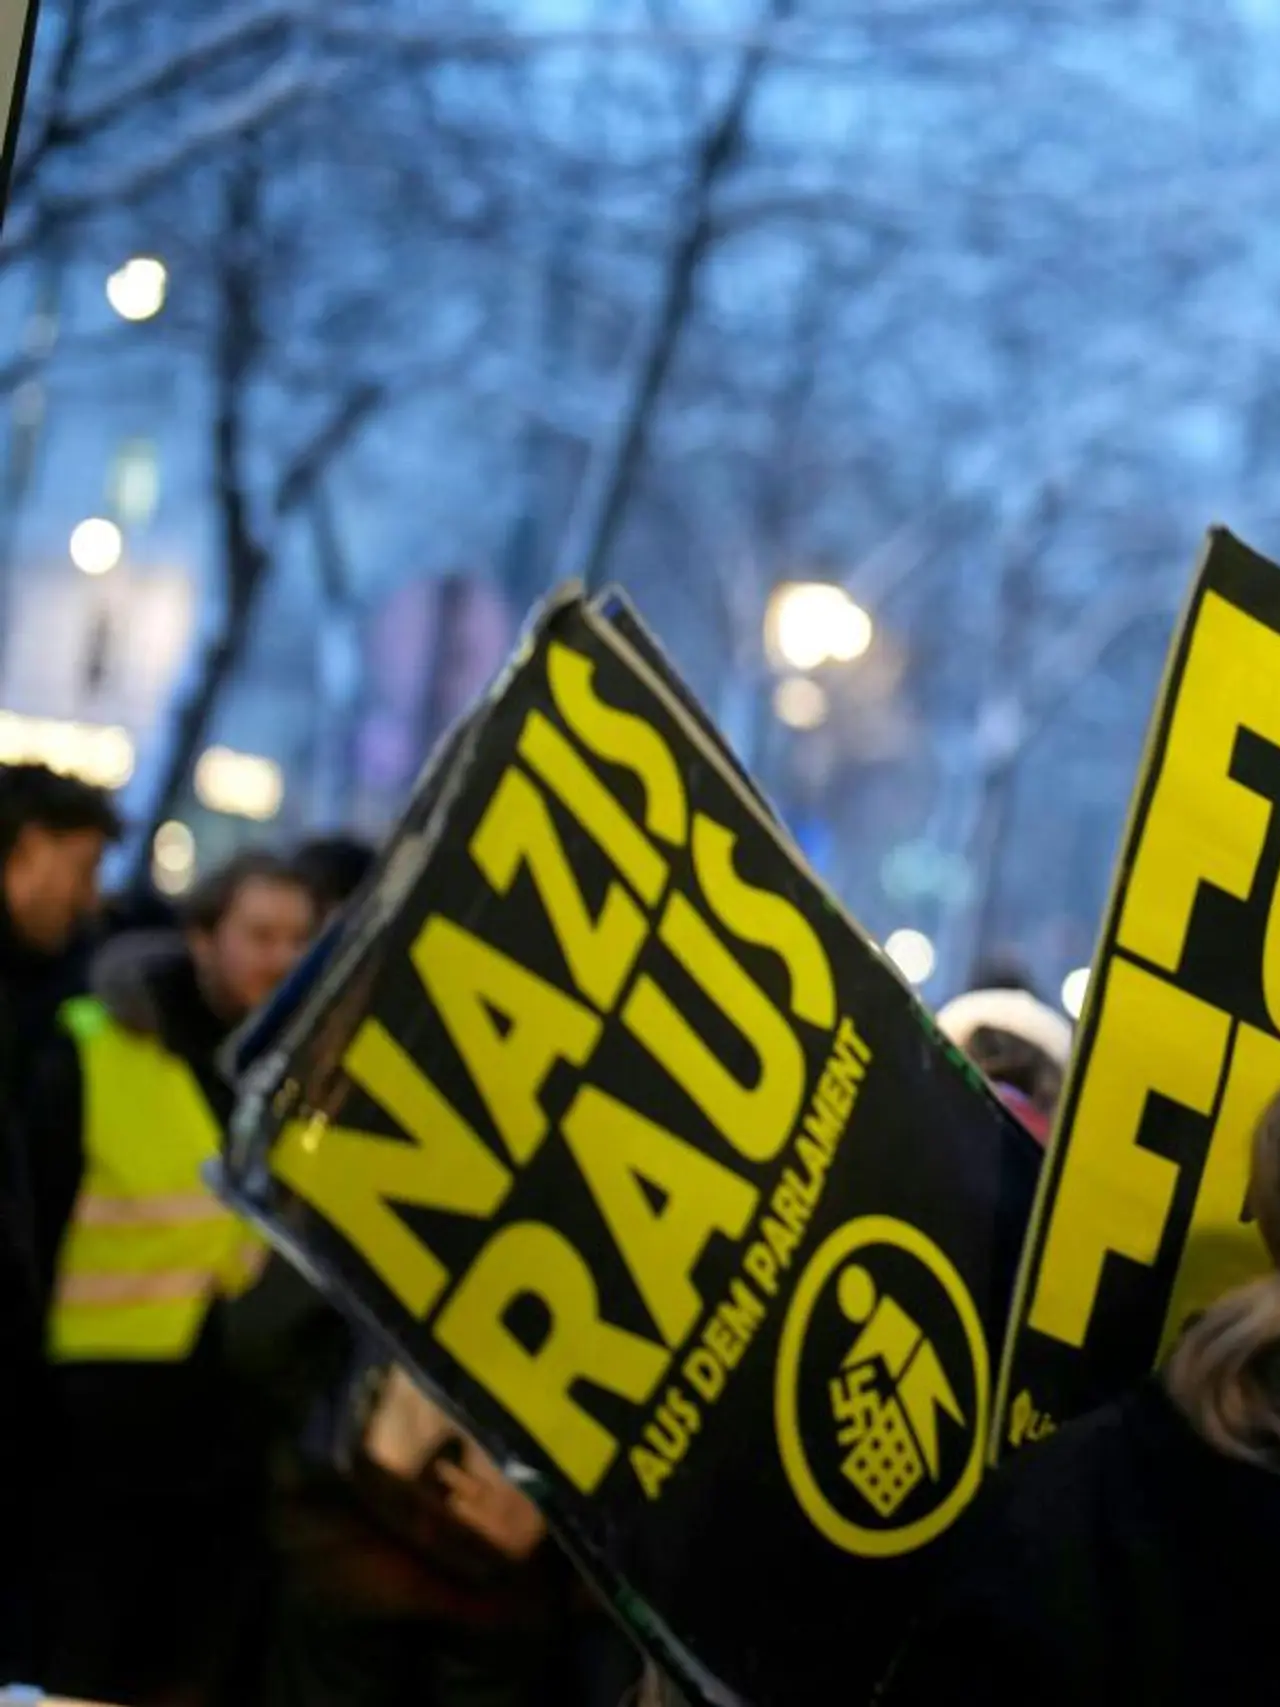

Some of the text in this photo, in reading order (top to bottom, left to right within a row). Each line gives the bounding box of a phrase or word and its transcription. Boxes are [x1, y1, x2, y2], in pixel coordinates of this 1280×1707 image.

[269, 642, 686, 1321] NAZIS
[433, 812, 837, 1496] RAUS
[629, 1015, 873, 1500] AUS DEM PARLAMENT
